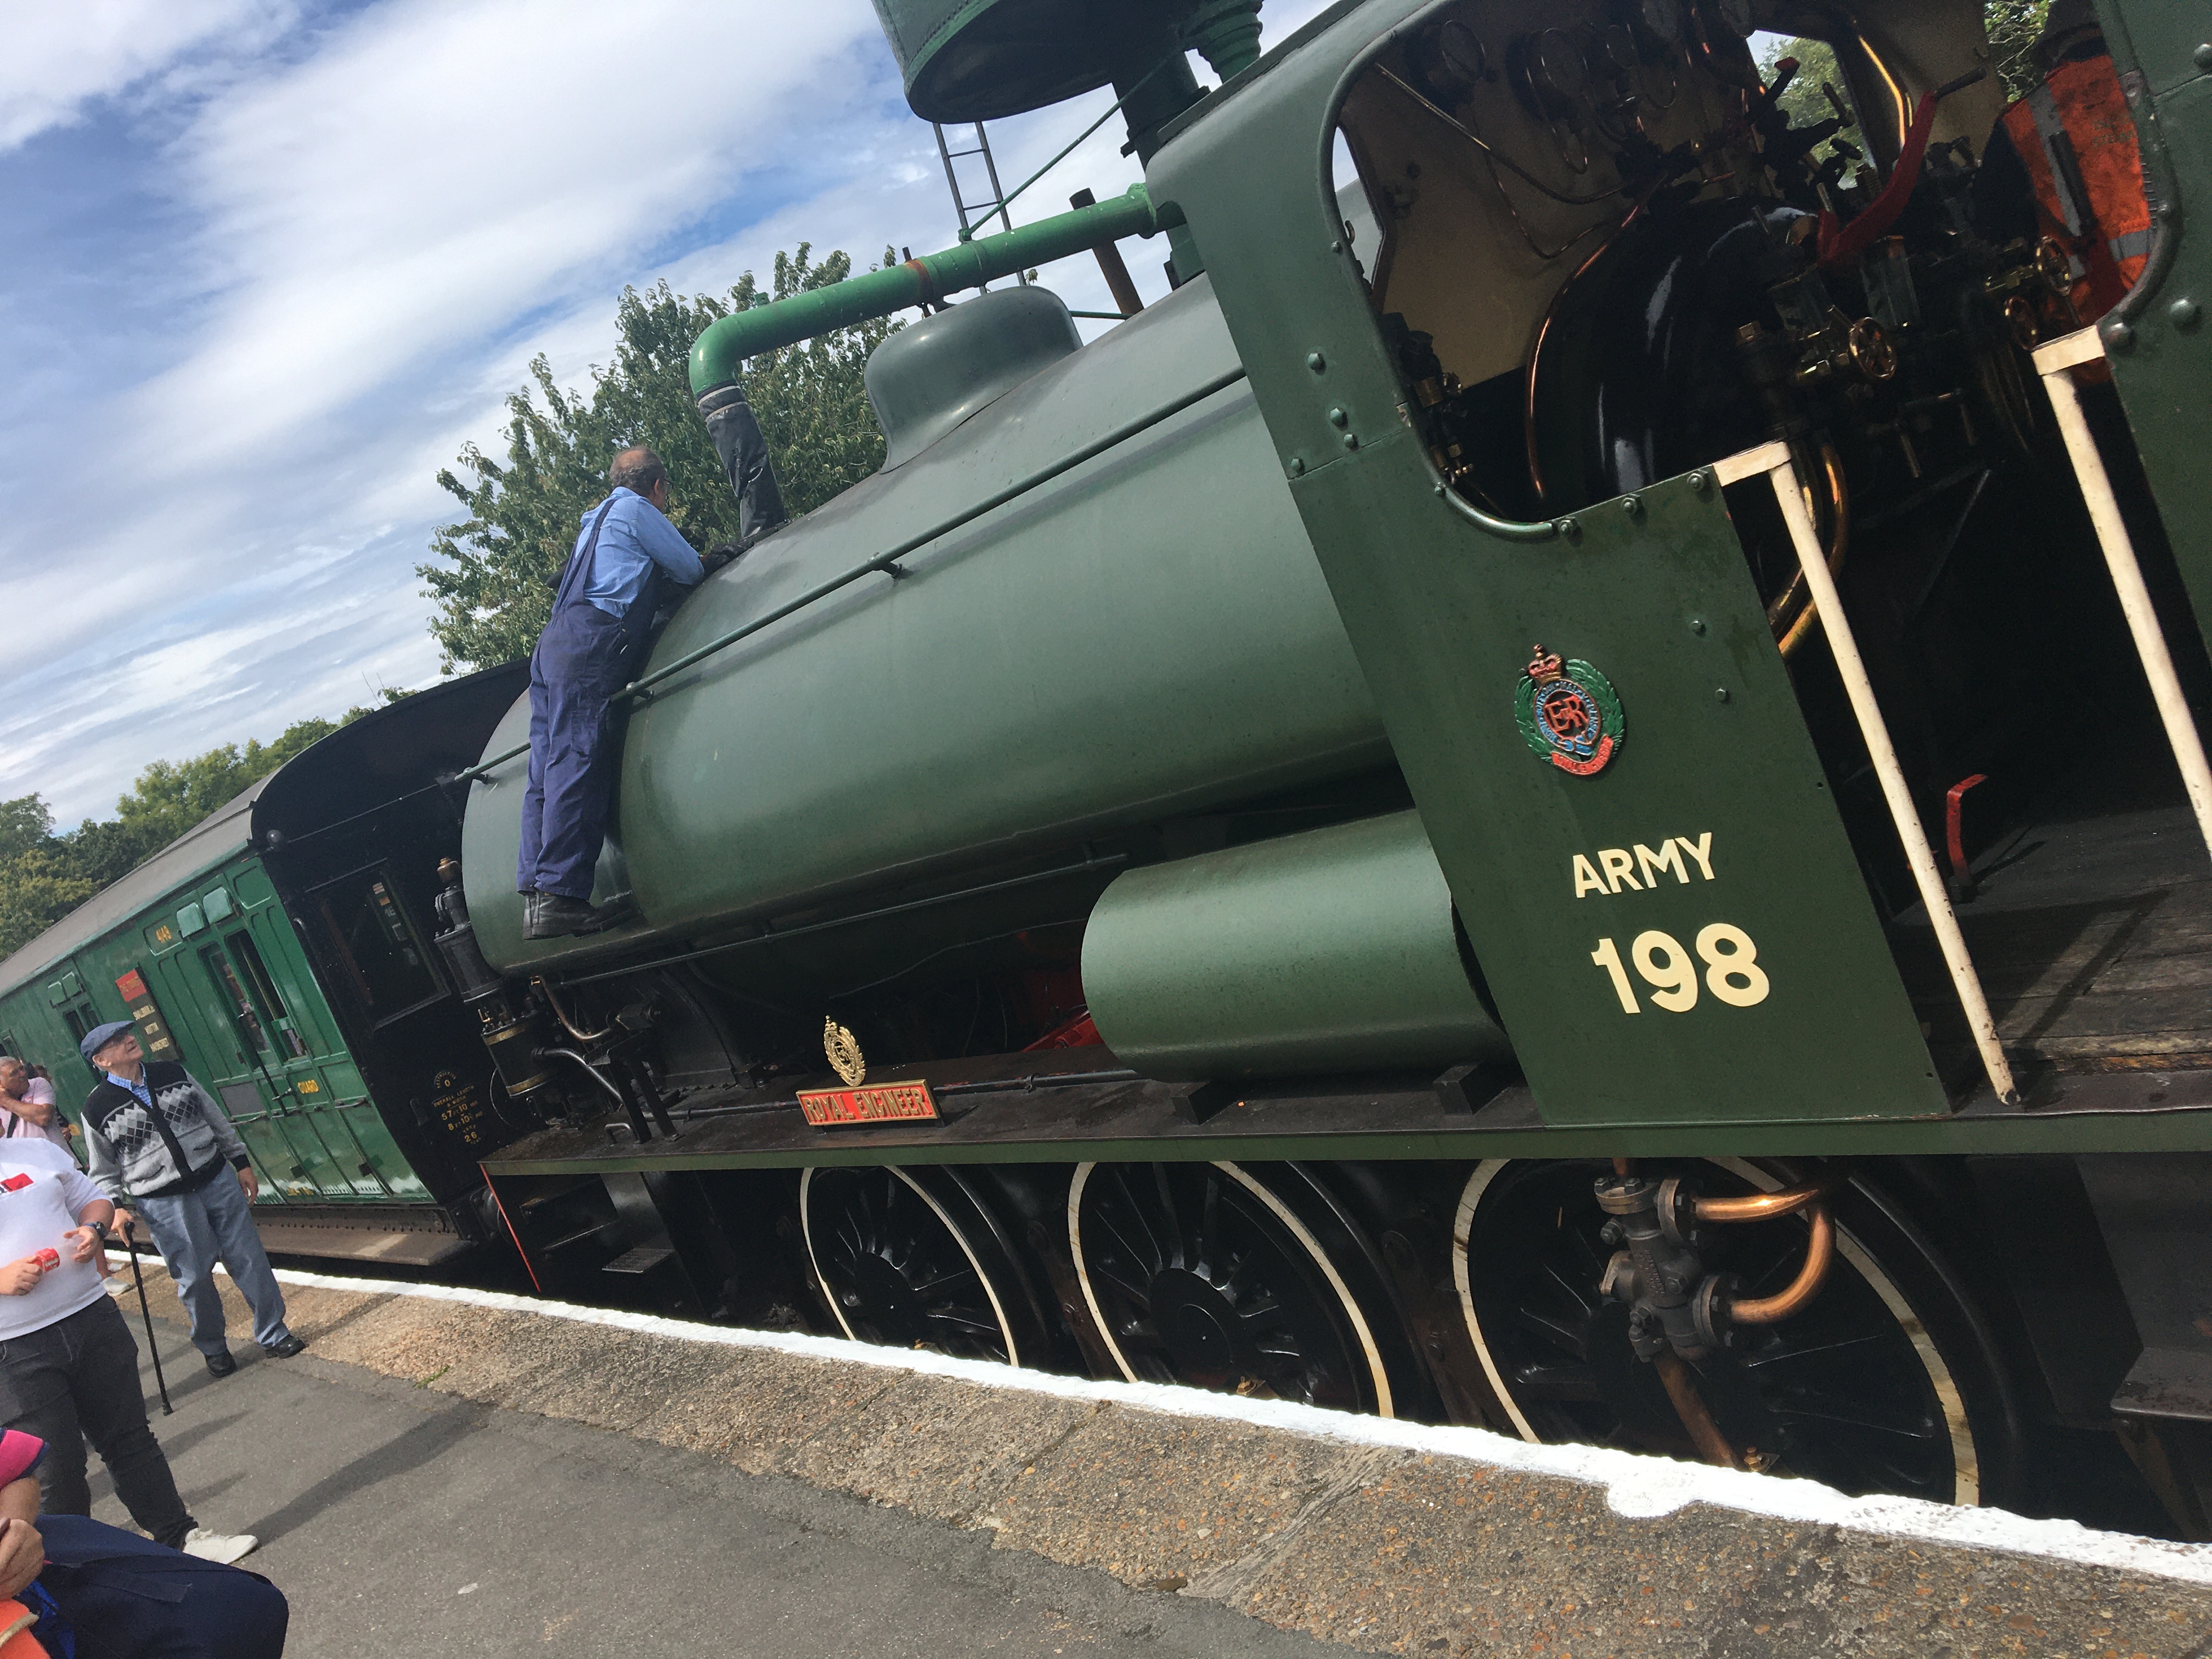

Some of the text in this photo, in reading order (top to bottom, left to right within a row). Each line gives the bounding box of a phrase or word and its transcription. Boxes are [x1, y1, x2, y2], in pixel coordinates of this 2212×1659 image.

[1572, 832, 1715, 898] ARMY
[1590, 923, 1770, 1014] 198
[297, 1079, 319, 1094] GUARD
[433, 1085, 474, 1107] OVERALL LENGTH
[459, 1103, 468, 1112] 10
[803, 1088, 932, 1121] ROYAL ENGINEER
[465, 1132, 477, 1142] 26
